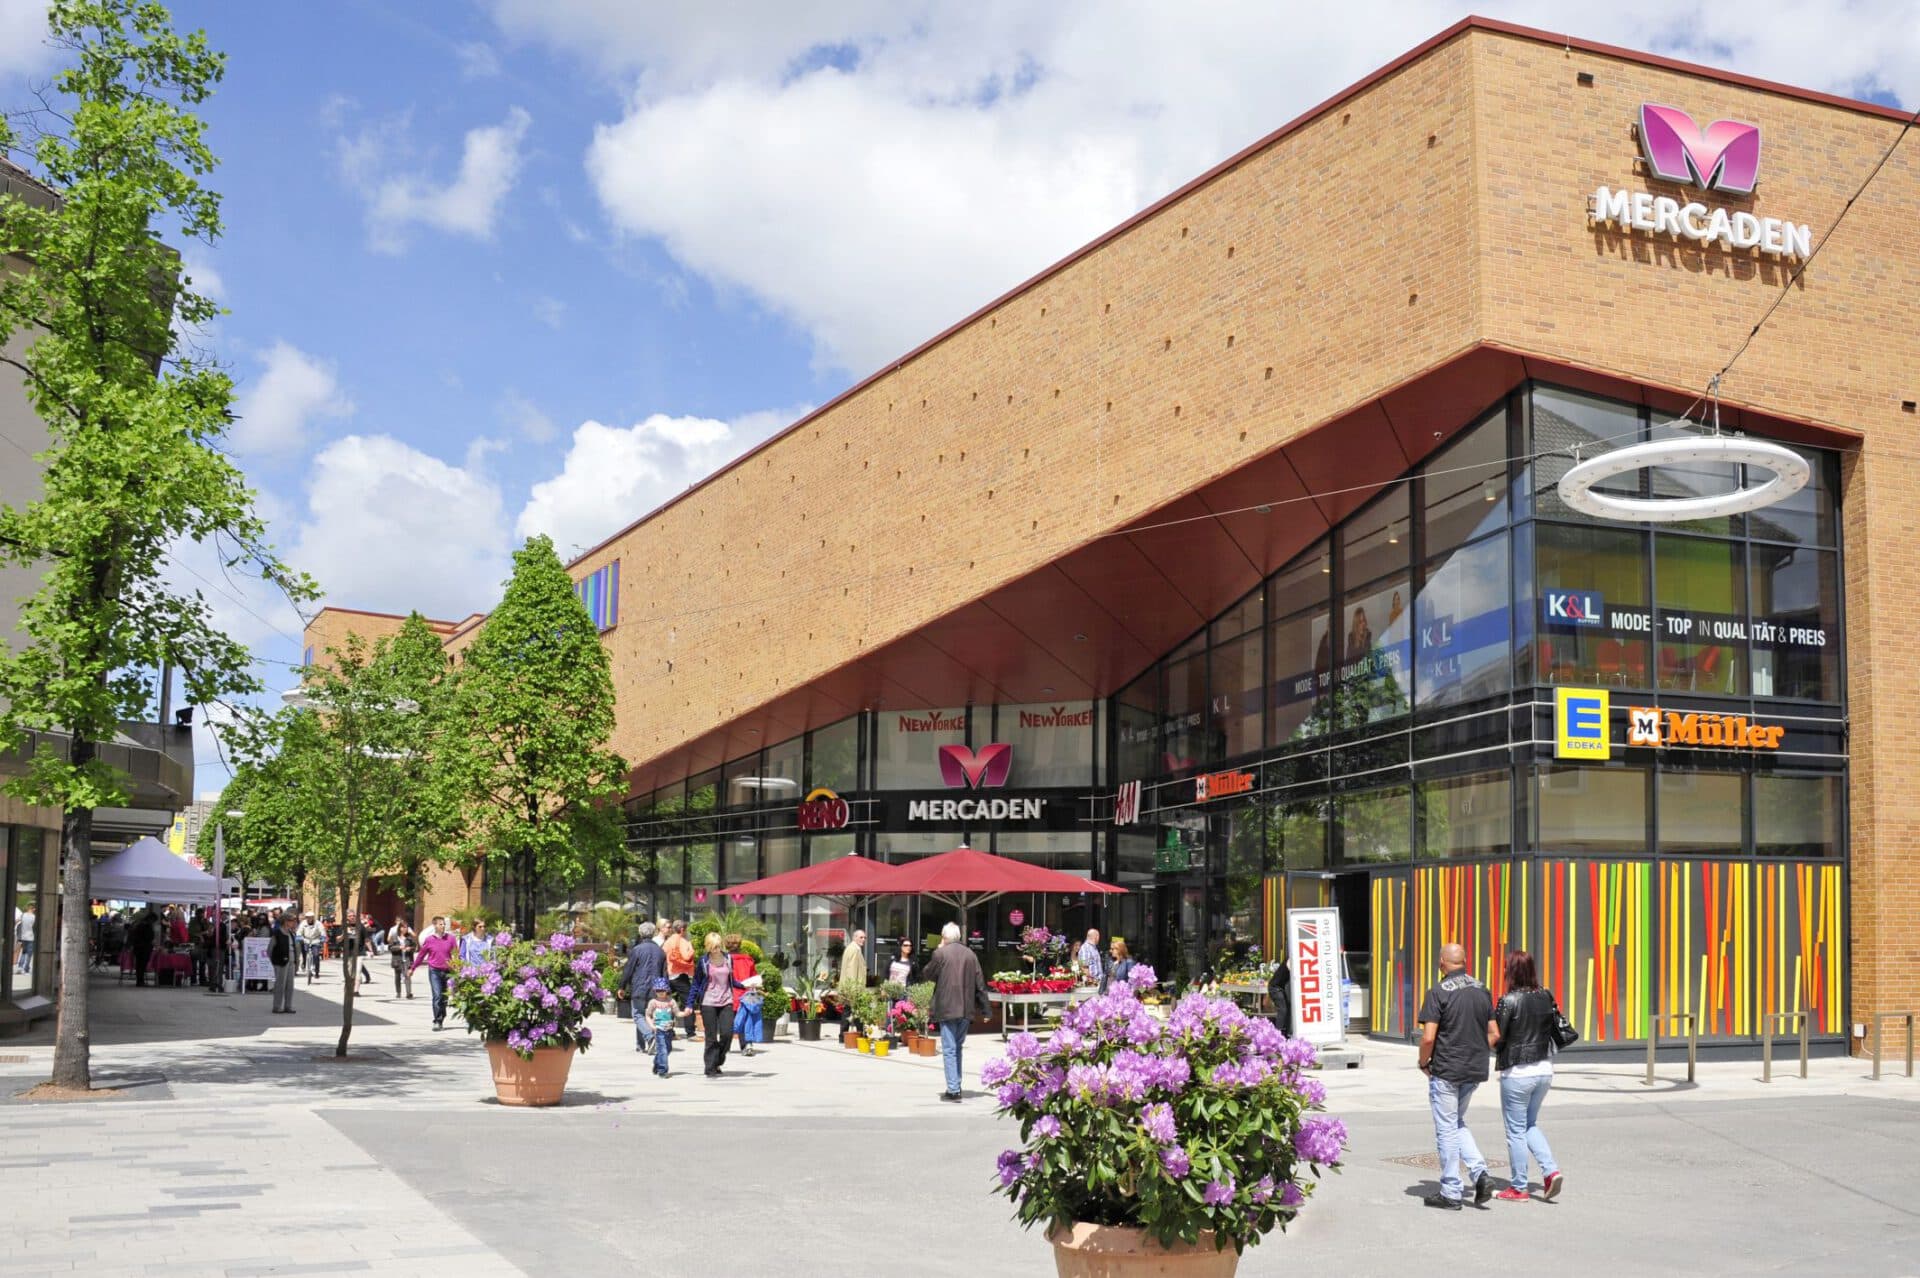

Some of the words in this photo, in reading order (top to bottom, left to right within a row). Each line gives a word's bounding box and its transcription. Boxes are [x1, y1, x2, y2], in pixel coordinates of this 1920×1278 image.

[1595, 186, 1811, 258] MERCADEN
[1549, 593, 1600, 619] K&L
[1423, 622, 1451, 649] KL
[1611, 612, 1651, 632] MODE
[1666, 617, 1692, 635] TOP
[1699, 620, 1711, 637] IN
[1778, 626, 1788, 644] &
[1790, 628, 1827, 647] PREIS
[1665, 712, 1785, 748] Müller
[1567, 741, 1603, 750] EDEKA
[1208, 770, 1254, 798] Müller
[908, 799, 1042, 821] MERCADEN
[1299, 940, 1321, 1023] STORZ
